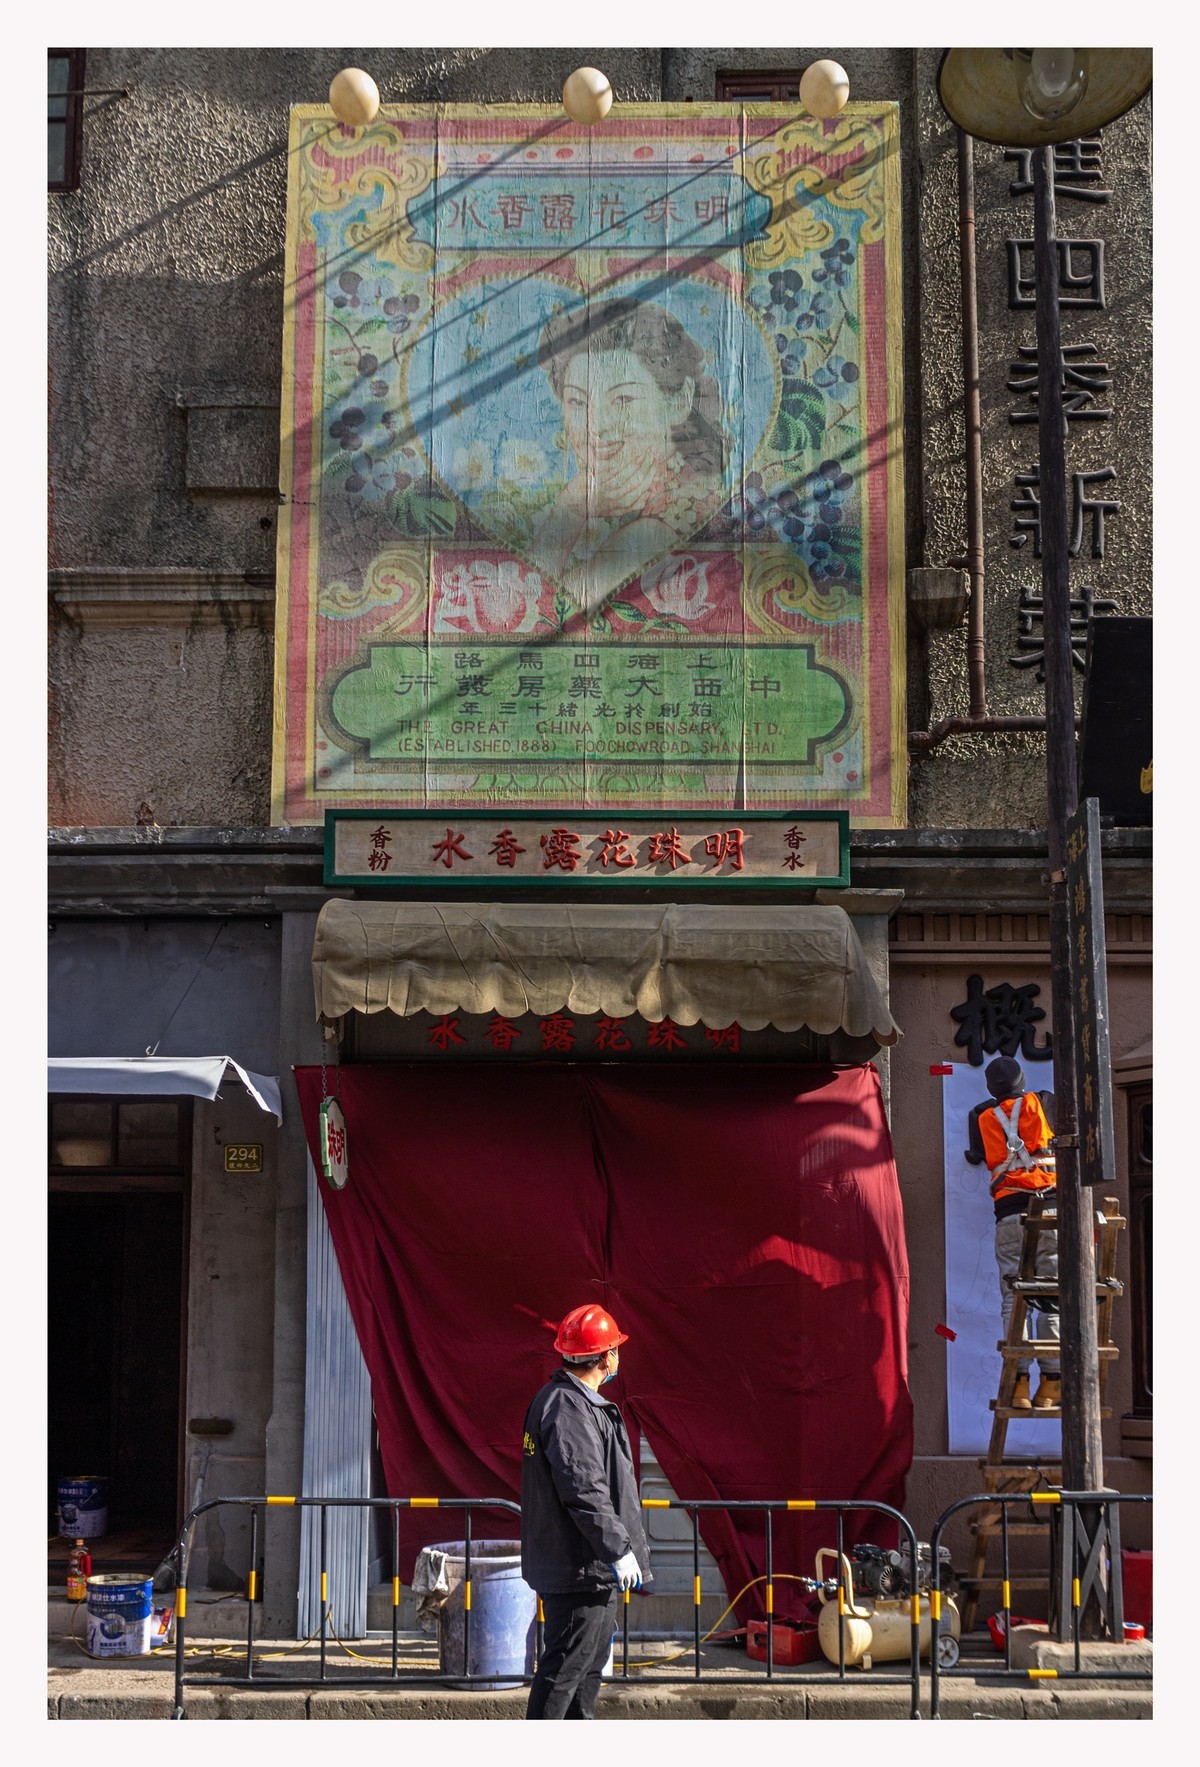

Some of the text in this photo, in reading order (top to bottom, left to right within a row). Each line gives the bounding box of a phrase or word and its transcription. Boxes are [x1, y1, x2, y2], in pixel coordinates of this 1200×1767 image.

[397, 719, 433, 734] THE
[451, 720, 508, 734] GREAT
[536, 720, 593, 735] CHINA
[615, 721, 724, 736] DISPENSARY,
[368, 825, 393, 872] 香粉
[432, 826, 744, 872] 明珠花露香水
[782, 825, 807, 872] 香水
[428, 1013, 741, 1051] 明珠花露香水
[229, 1148, 257, 1160] 294
